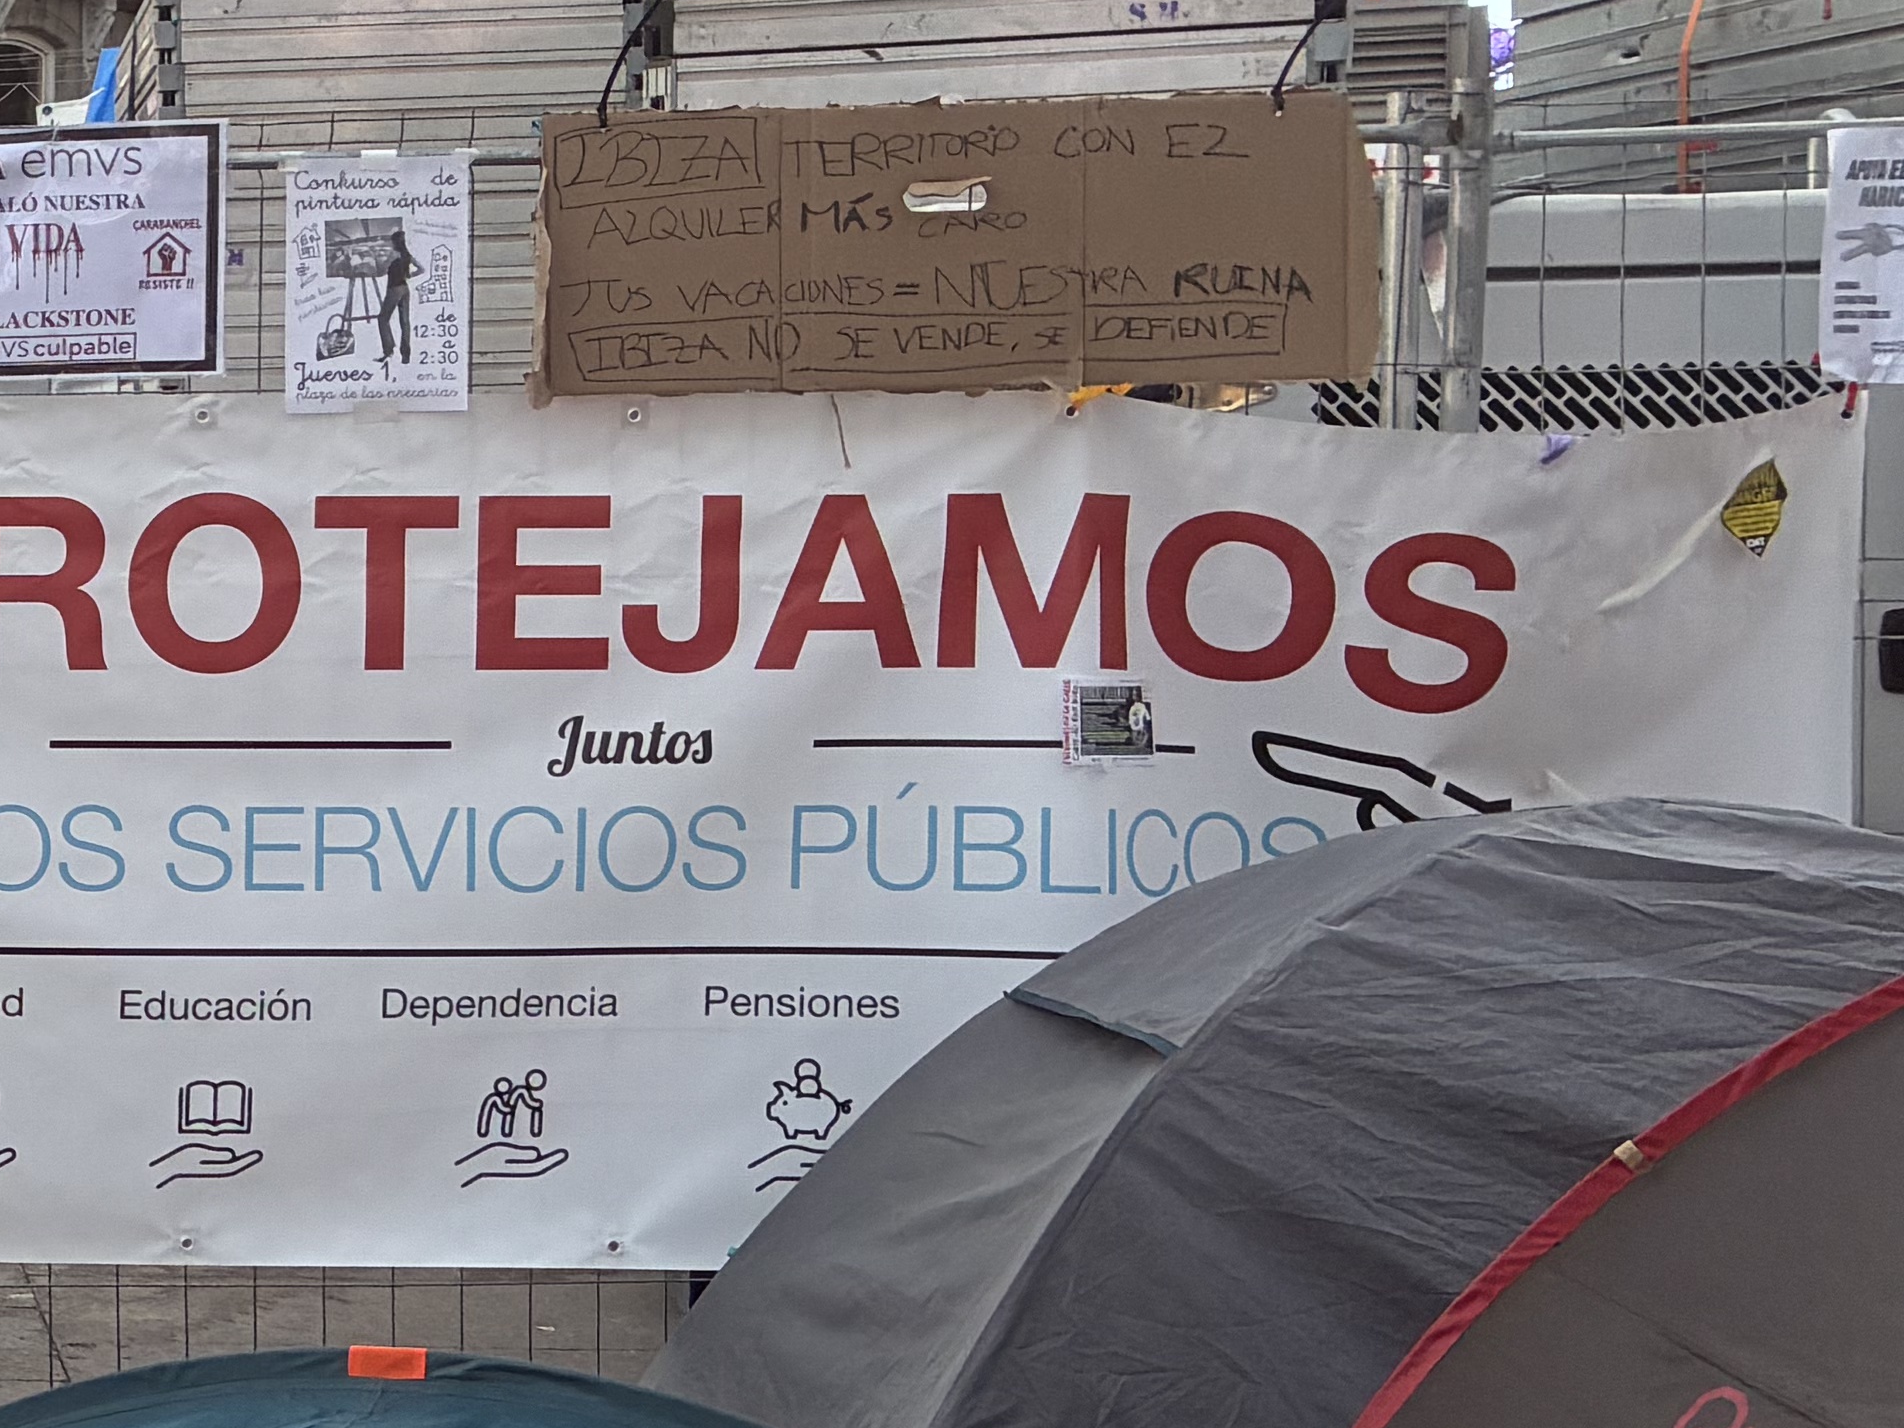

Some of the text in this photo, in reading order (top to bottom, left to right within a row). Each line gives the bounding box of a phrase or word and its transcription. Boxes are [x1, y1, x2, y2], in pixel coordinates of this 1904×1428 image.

[21, 145, 143, 179] emvs
[570, 128, 751, 188] IBIZA
[1054, 126, 1136, 160] CON
[431, 167, 458, 186] de
[44, 193, 146, 213] NUESTRA
[295, 188, 460, 218] pintura rápida
[800, 193, 893, 235] MÁS
[561, 277, 654, 315] TUS
[677, 275, 886, 308] VACACIONES
[932, 260, 1148, 312] NUESTRA
[1173, 264, 1314, 305] RUINA
[435, 307, 457, 323] de
[413, 324, 459, 339] 12:30
[585, 329, 729, 369] IBIZA
[748, 322, 802, 363] NO
[835, 324, 880, 362] SE
[1038, 326, 1069, 347] SE
[33, 336, 132, 361] culpable
[419, 351, 459, 365] 2:30
[294, 361, 373, 390] Jueves
[547, 714, 715, 778] Juntos
[165, 804, 749, 895] SERVICIOS
[117, 986, 313, 1023] Educación
[380, 985, 619, 1024] Dependencia
[703, 984, 903, 1021] Pensiones
